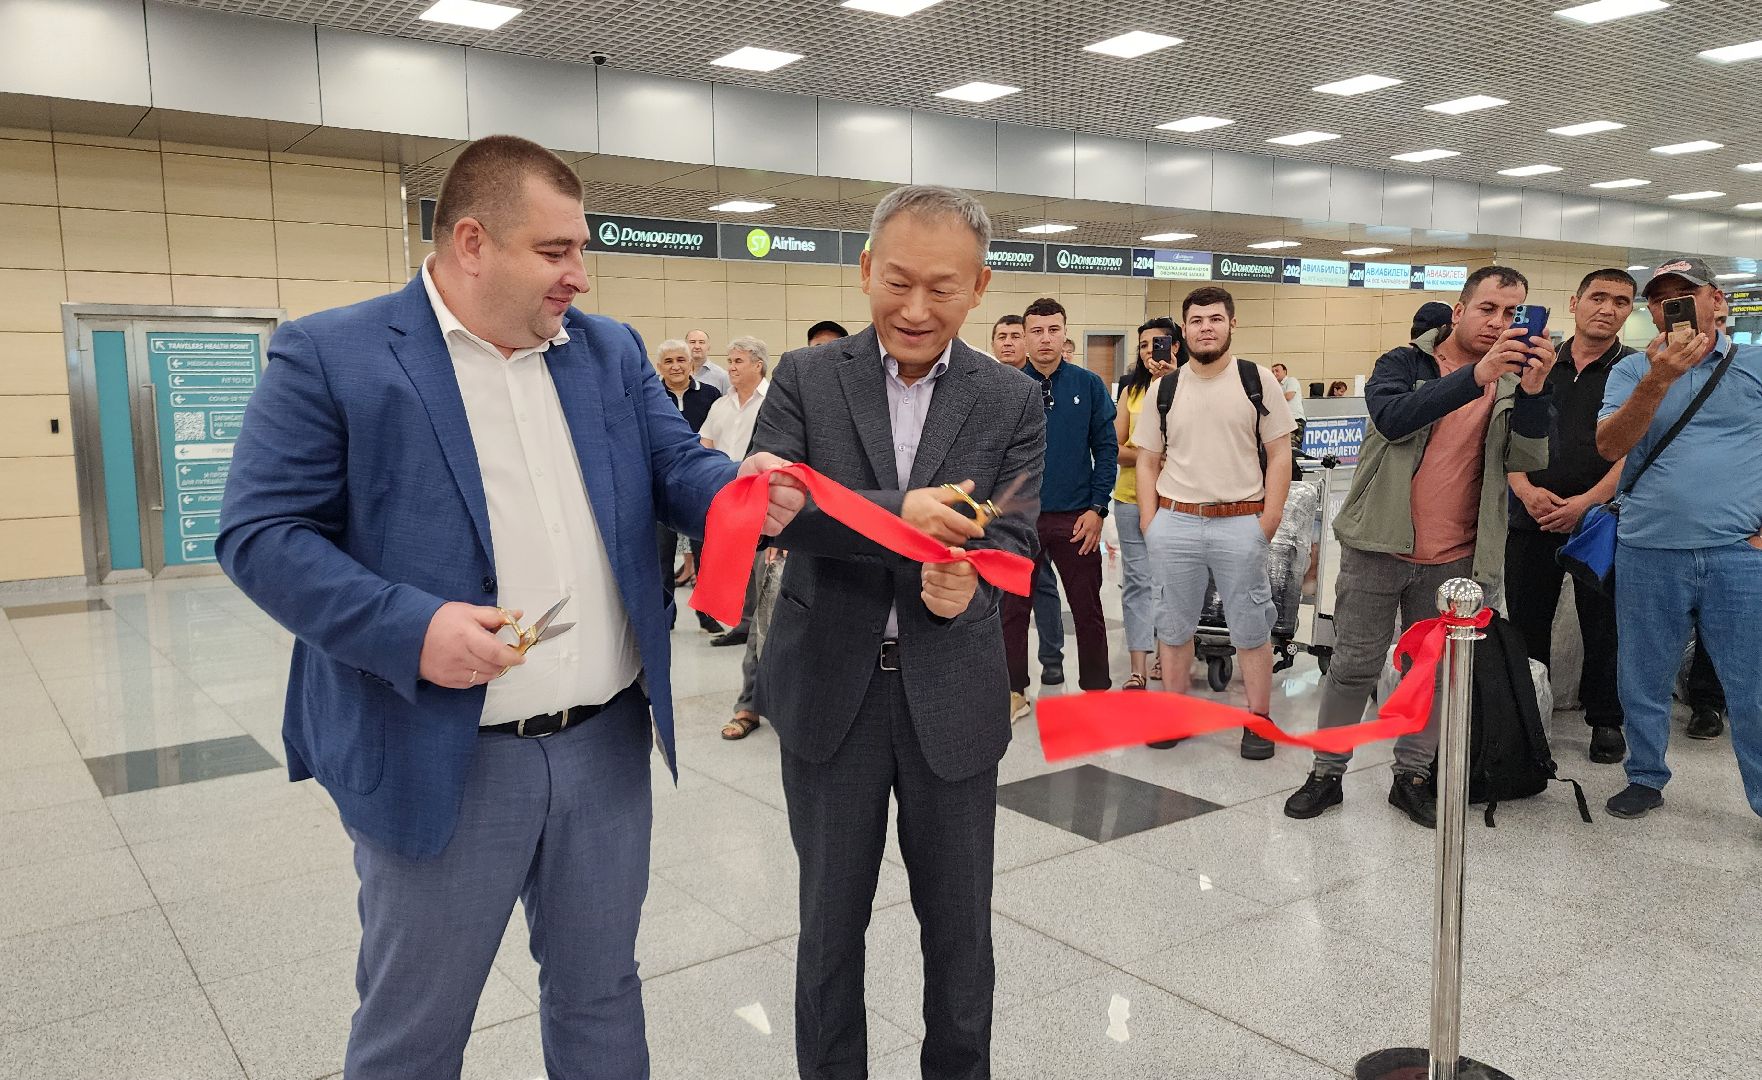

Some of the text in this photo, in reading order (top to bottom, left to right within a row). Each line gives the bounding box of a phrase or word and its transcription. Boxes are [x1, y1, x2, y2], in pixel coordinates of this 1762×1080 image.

[621, 227, 703, 246] DOMODEDOVO
[771, 235, 816, 252] Airlines
[1070, 253, 1123, 267] DOMODEDOVO
[1231, 262, 1275, 275] DOMODEDOVO
[1302, 263, 1347, 275] АВИАБИЛЕТЫ
[1366, 267, 1409, 277] АВИАБИЛЕТЫ
[1426, 269, 1467, 279] АВИАБИЛЕТЫ
[1305, 428, 1363, 446] ПРОДАЖА
